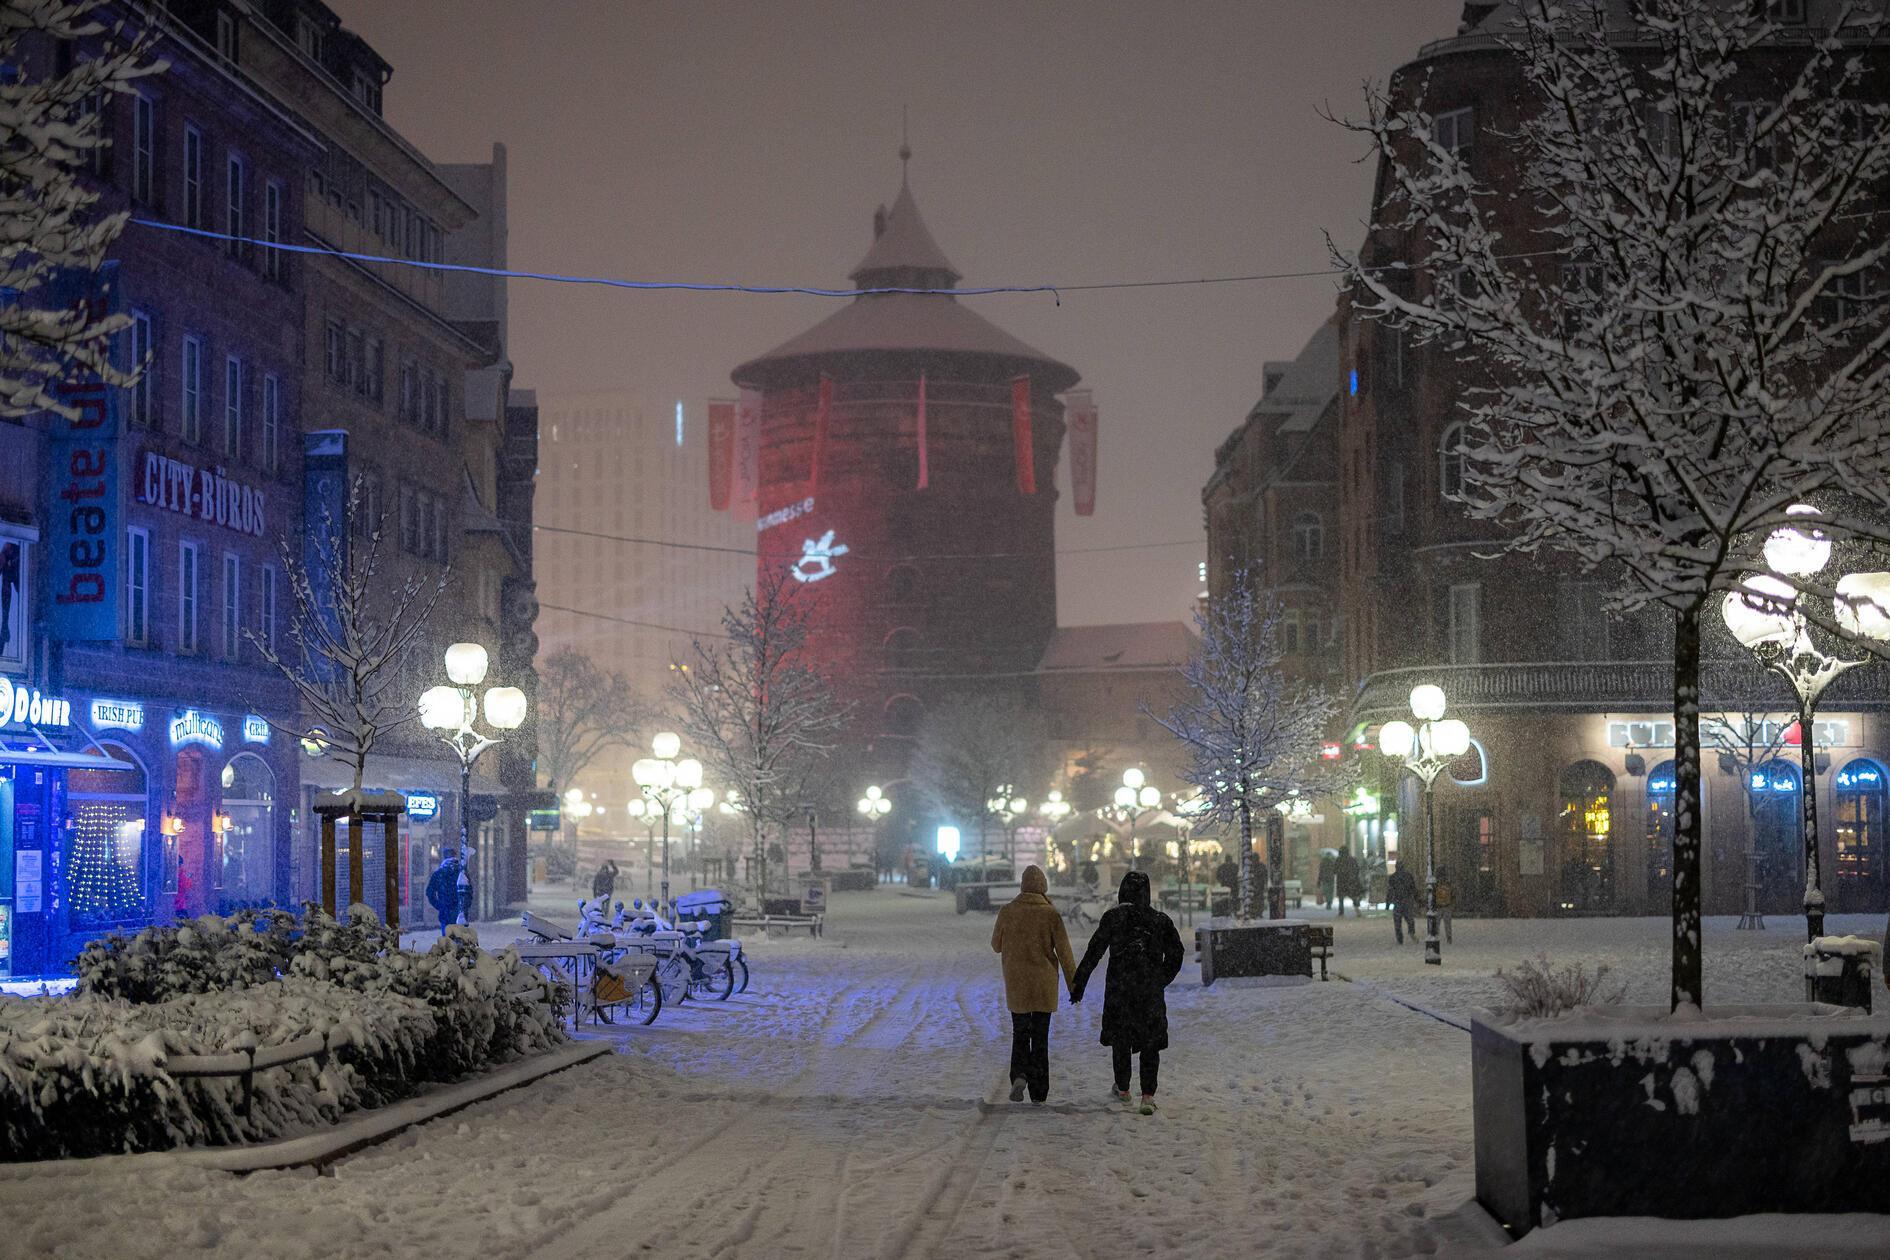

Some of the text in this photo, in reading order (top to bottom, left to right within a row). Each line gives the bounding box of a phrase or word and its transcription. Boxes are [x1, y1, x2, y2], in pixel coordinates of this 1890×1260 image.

[144, 451, 265, 537] CITY-BÜROS
[56, 448, 106, 605] beate
[14, 686, 70, 727] DÖNER
[97, 705, 145, 725] IRISH PUB
